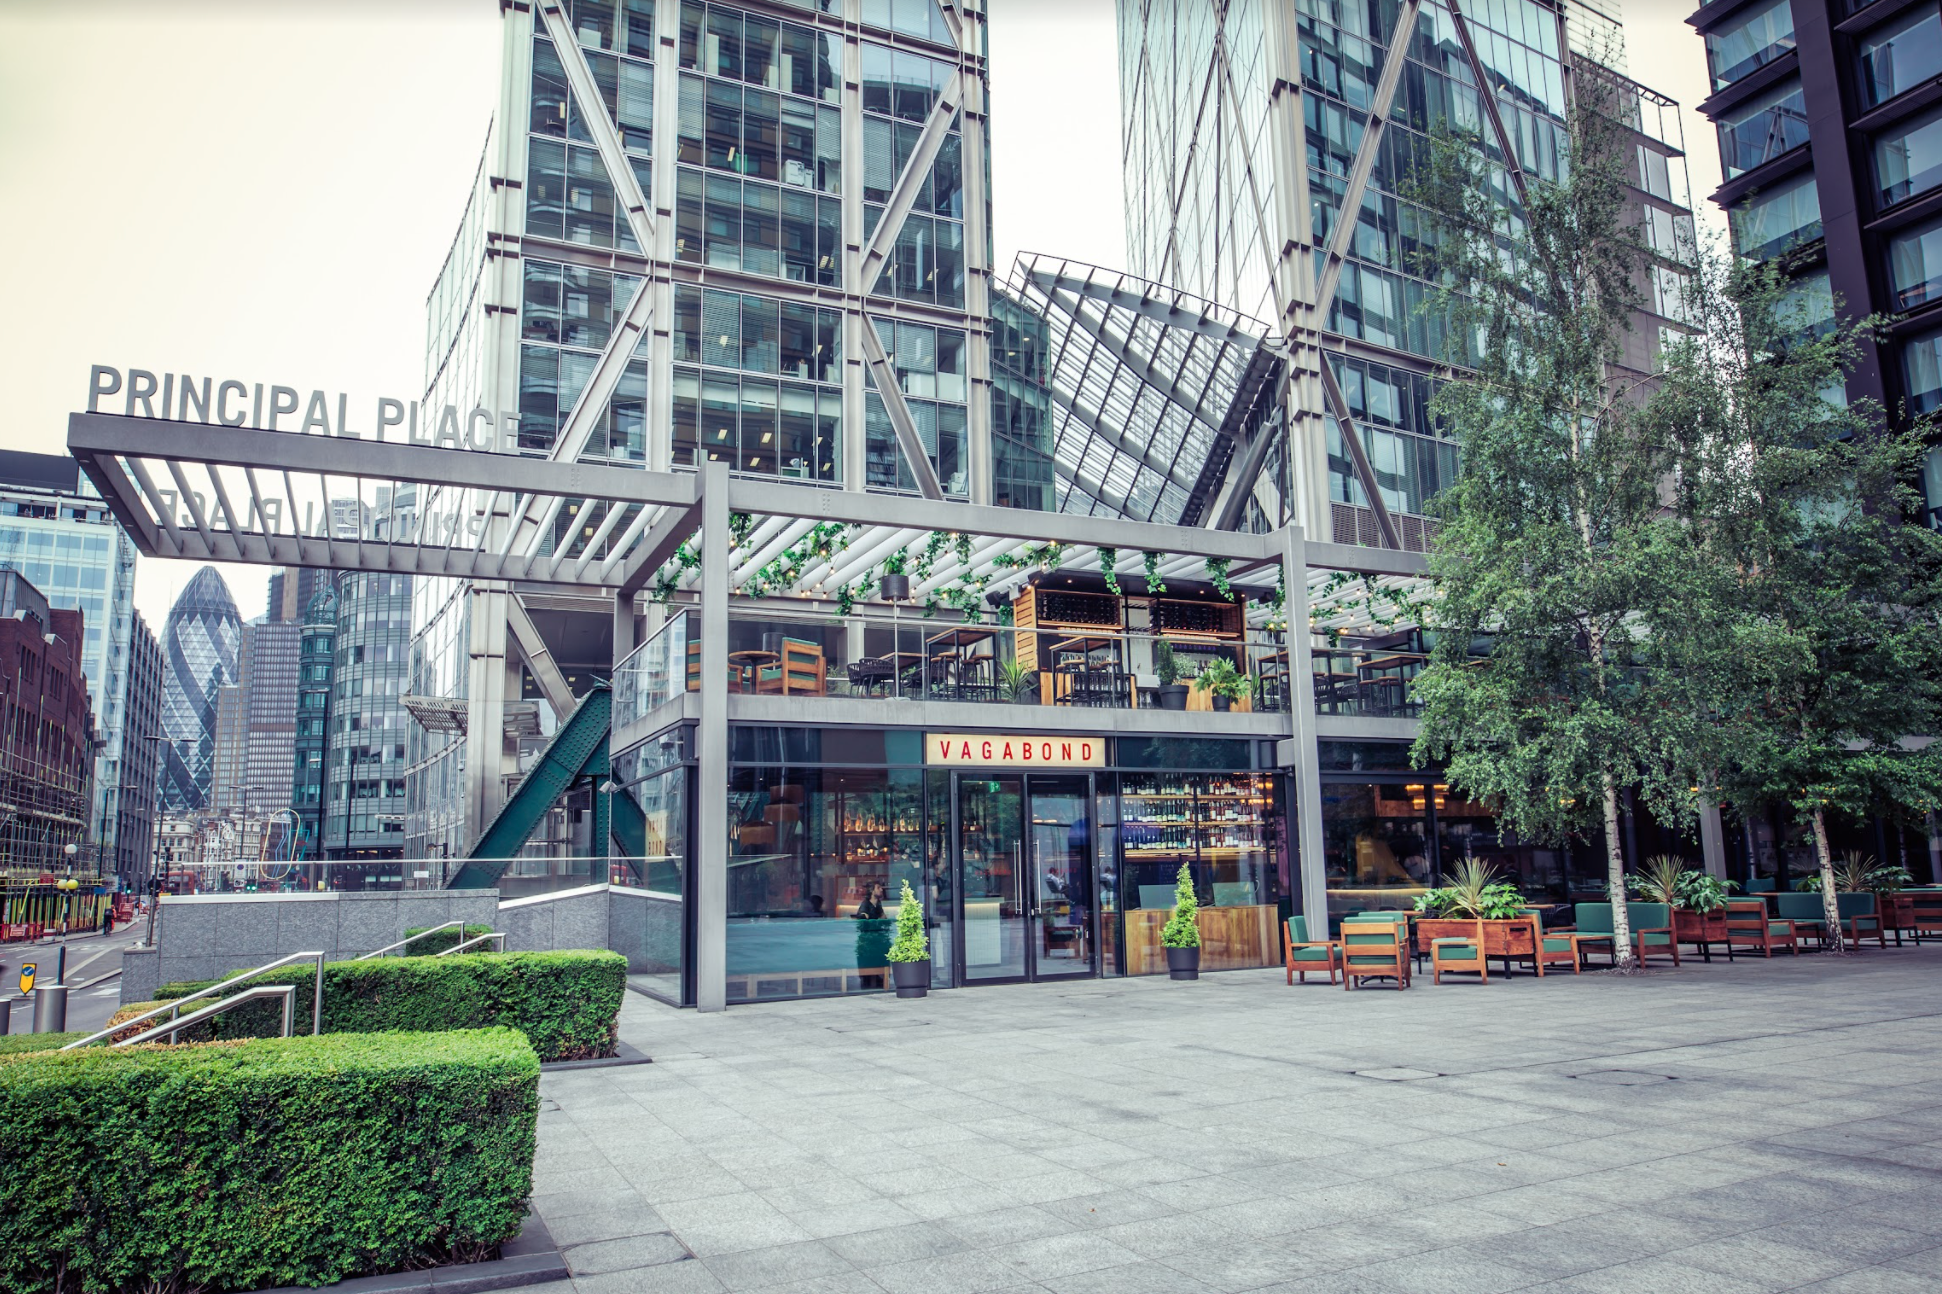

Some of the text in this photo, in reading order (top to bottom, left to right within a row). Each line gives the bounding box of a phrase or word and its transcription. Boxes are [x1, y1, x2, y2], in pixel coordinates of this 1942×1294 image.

[87, 364, 522, 456] PRINCIPAL PLACE
[940, 740, 1091, 761] VAGABOND
